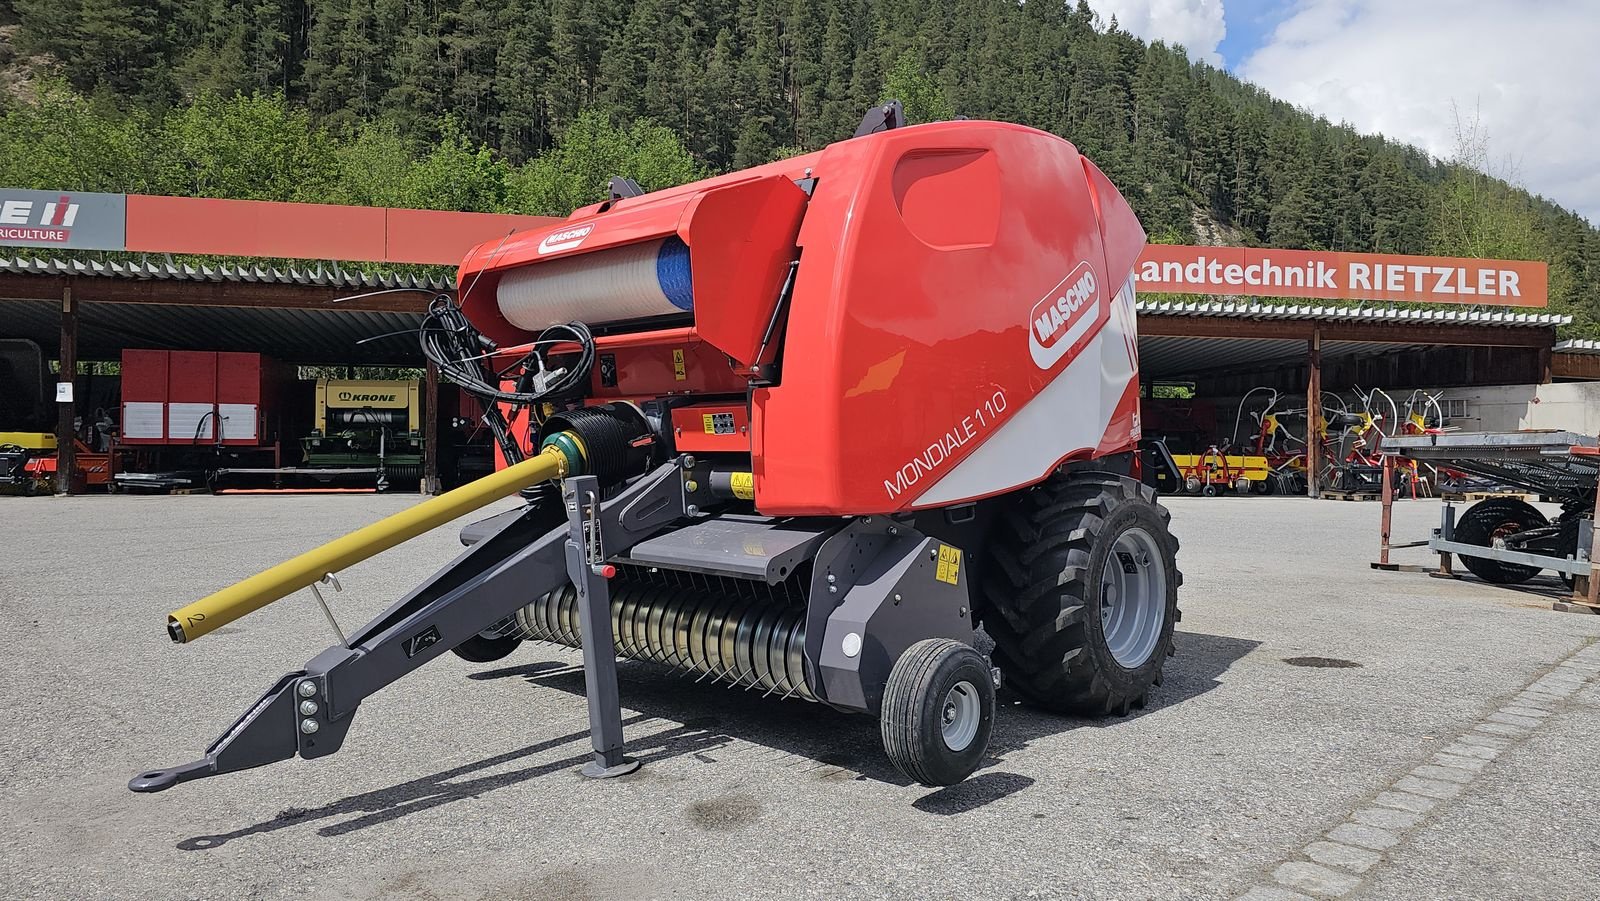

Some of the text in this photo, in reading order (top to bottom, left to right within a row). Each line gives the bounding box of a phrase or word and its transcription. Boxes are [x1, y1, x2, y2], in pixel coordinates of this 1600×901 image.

[546, 226, 591, 244] MASCHIO
[1134, 256, 1521, 297] andtechnik RIETZLER
[1034, 271, 1096, 342] MASCHIO
[352, 394, 397, 402] KRONE
[883, 391, 1007, 500] MONDIALE 110
